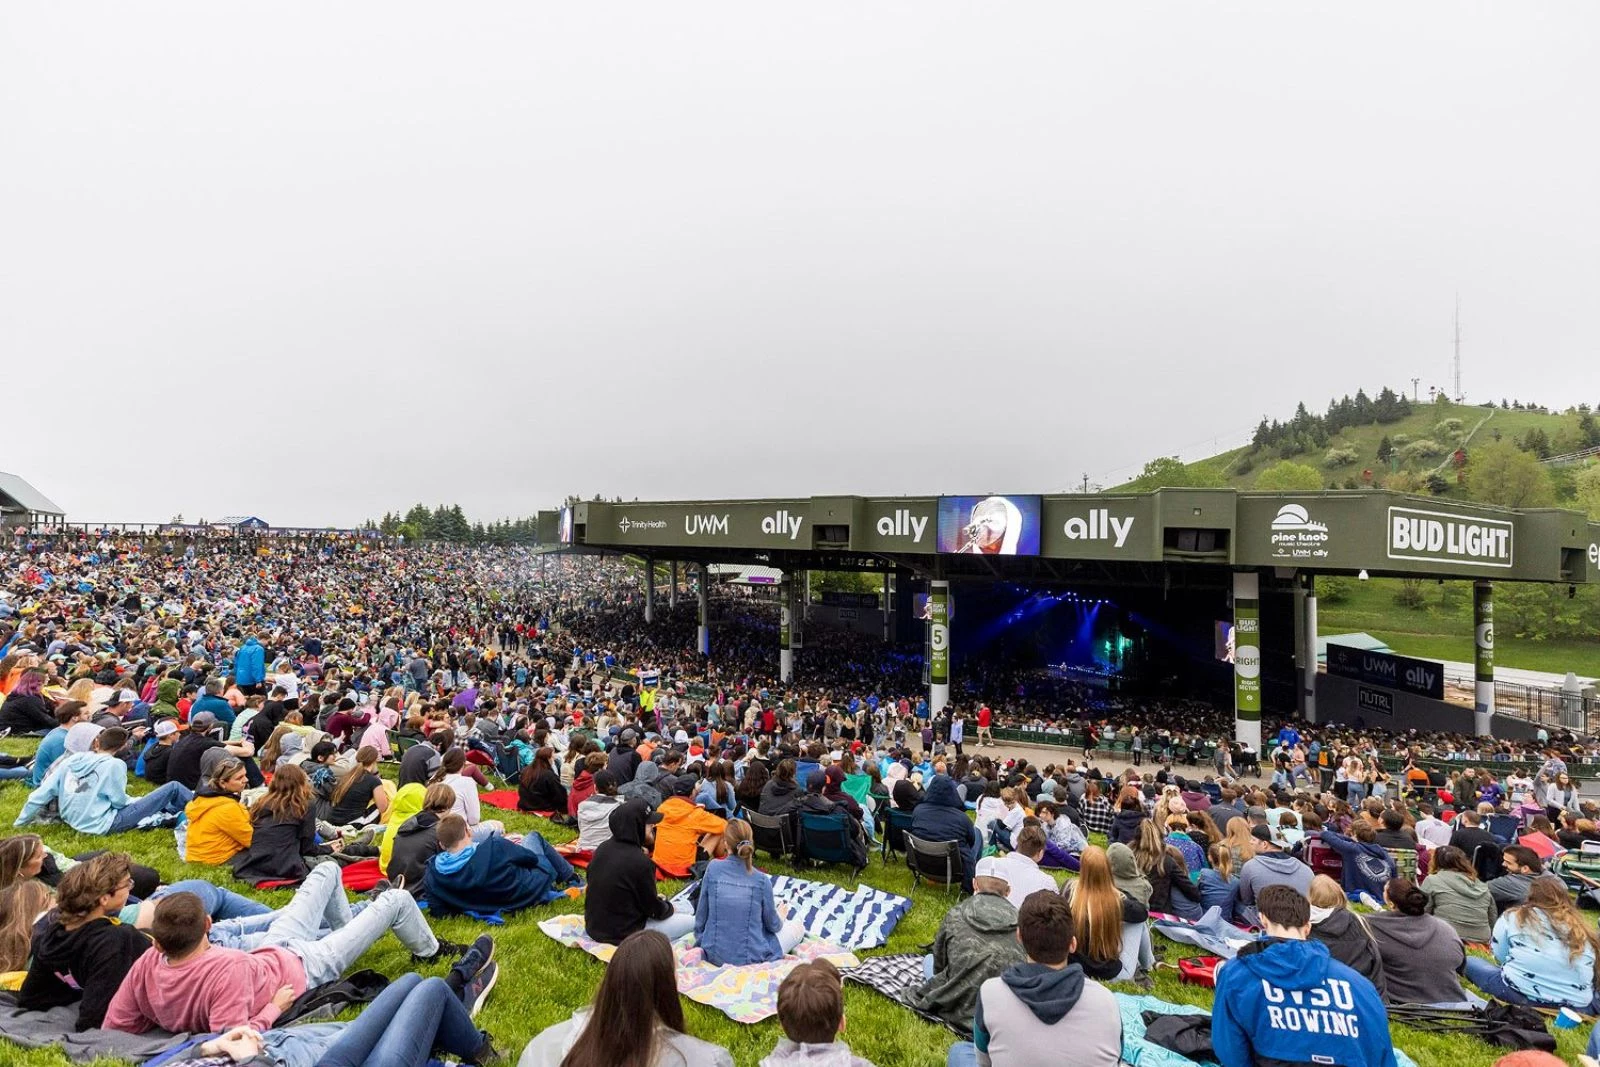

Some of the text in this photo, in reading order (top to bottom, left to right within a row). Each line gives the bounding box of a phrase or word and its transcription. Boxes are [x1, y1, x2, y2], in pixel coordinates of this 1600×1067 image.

[631, 520, 667, 530] Trinity Health
[685, 514, 729, 535] UWM
[761, 510, 803, 540] ally
[876, 509, 929, 543] ally
[1063, 508, 1135, 548] ally
[1393, 516, 1444, 552] BUD
[1271, 532, 1329, 544] pine knob
[1588, 543, 1600, 570] e
[933, 630, 943, 645] 5
[1236, 624, 1258, 632] LIGHT
[1484, 628, 1493, 644] 6
[1236, 656, 1260, 666] RIGHT
[1363, 655, 1397, 677] UWM
[1405, 666, 1436, 690] ally
[1266, 1005, 1359, 1038] ROWING
